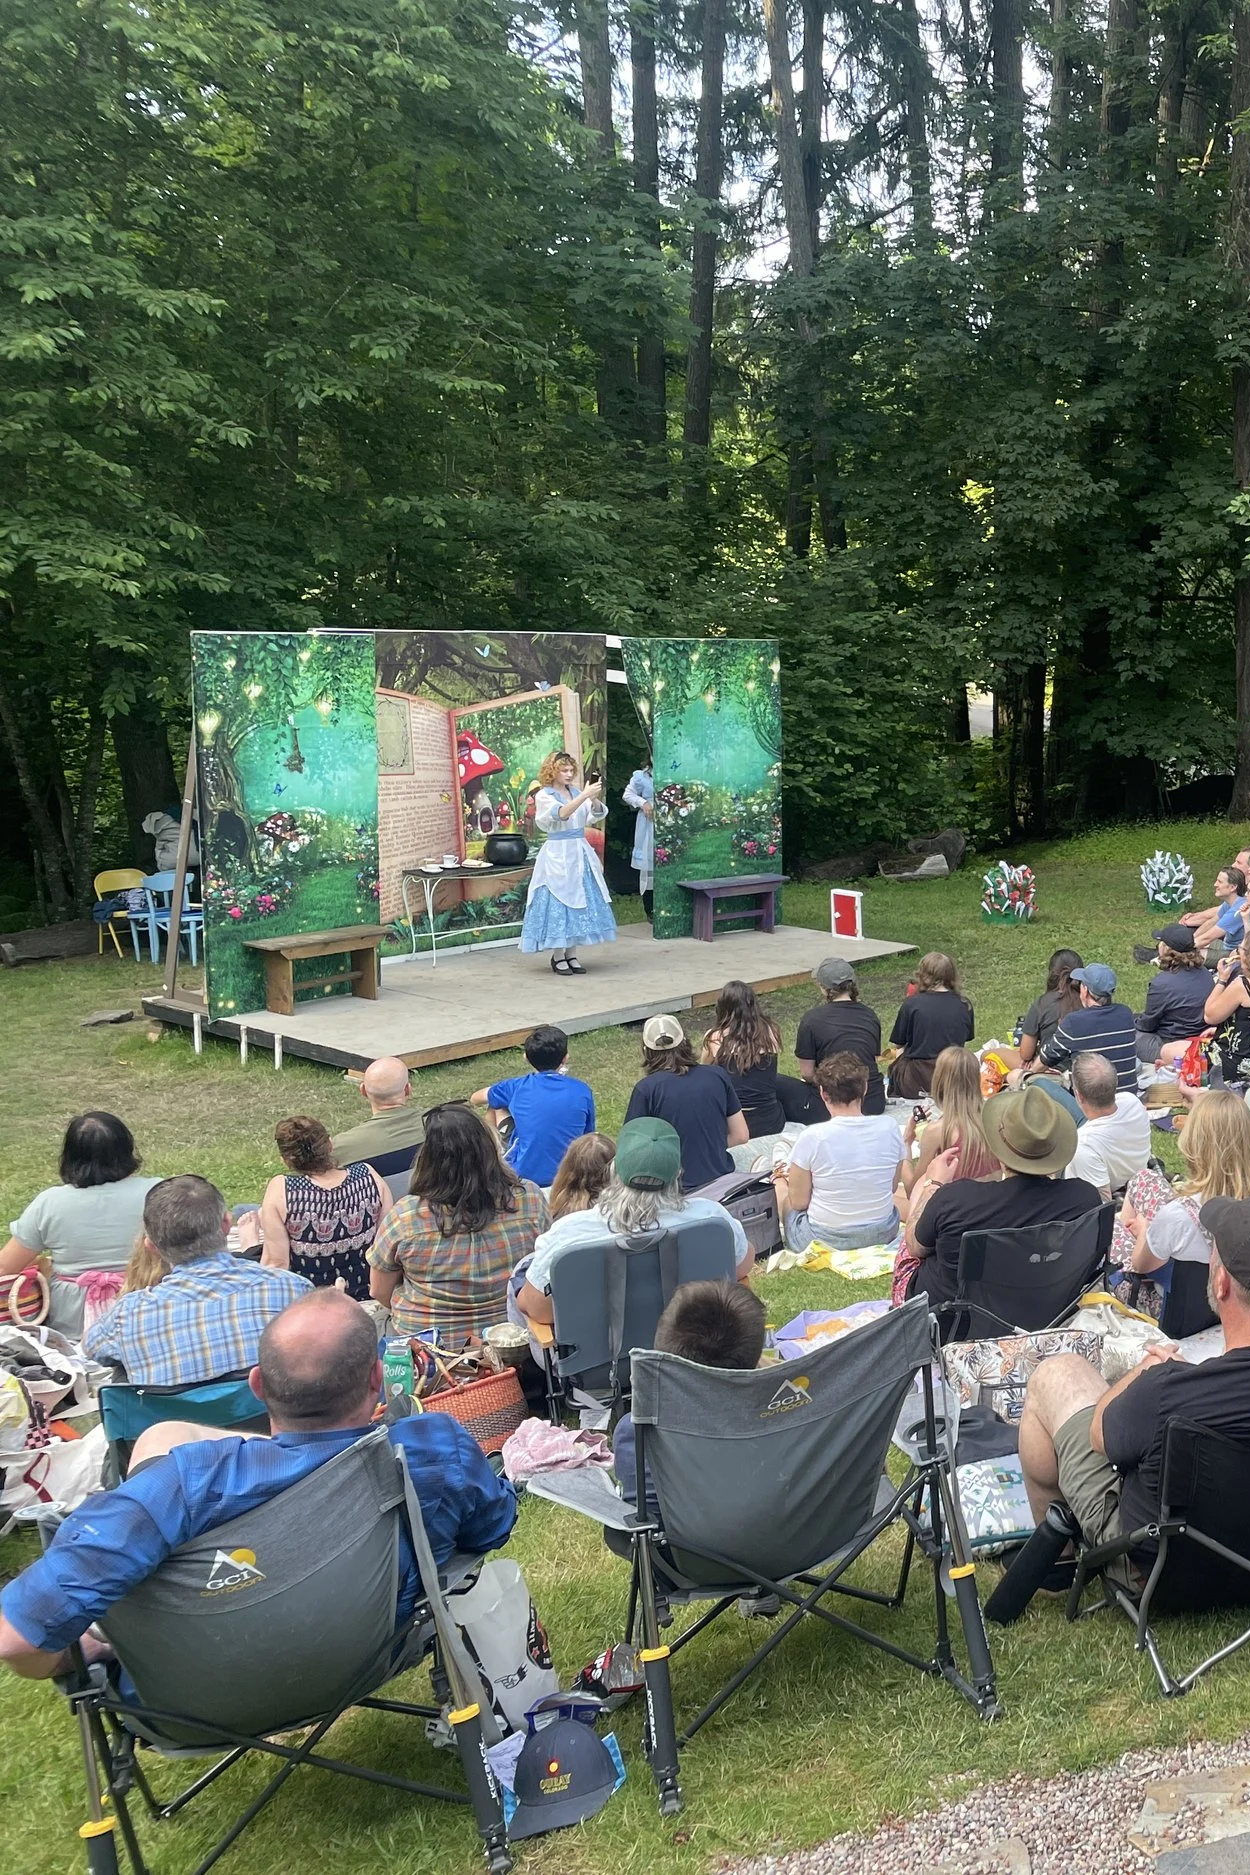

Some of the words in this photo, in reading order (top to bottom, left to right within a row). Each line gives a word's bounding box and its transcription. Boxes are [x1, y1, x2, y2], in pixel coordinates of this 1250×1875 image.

[383, 1364, 407, 1378] Rolls
[768, 1393, 801, 1410] GCI
[200, 1576, 263, 1597] OUTDOOR
[206, 1570, 251, 1590] GCI
[647, 1689, 658, 1749] KICKBACK
[478, 1741, 497, 1799] KICKBACK
